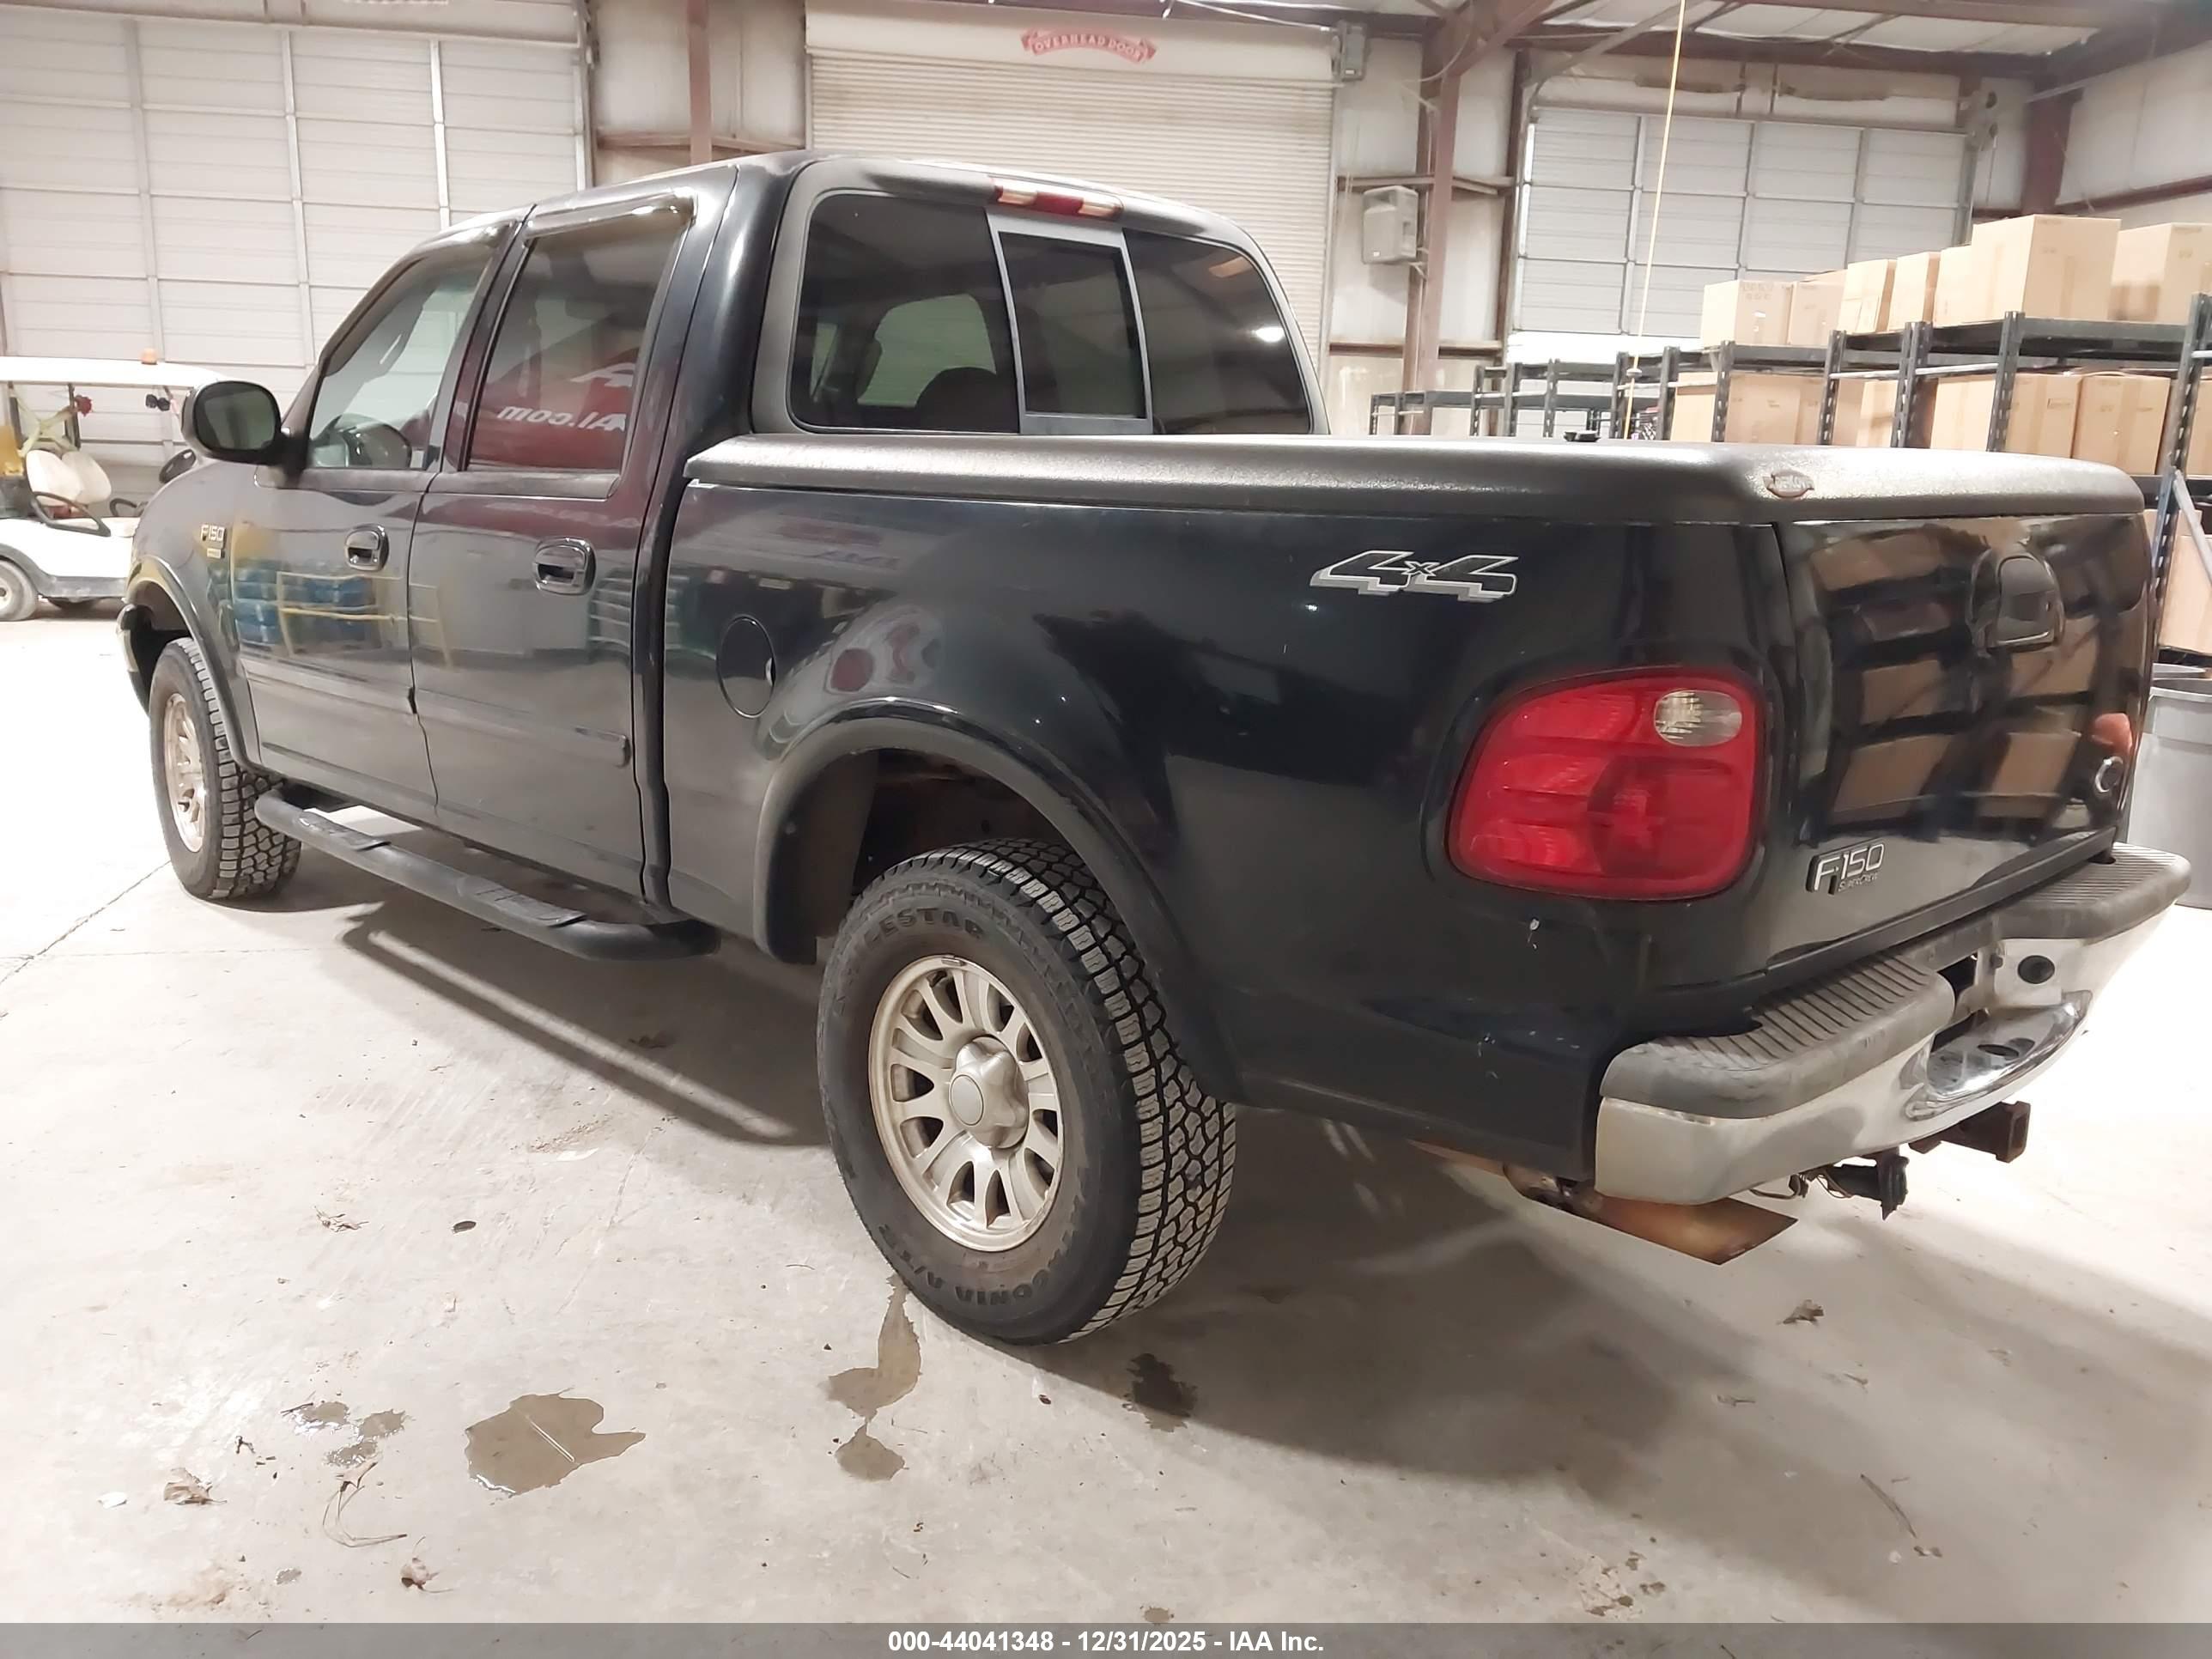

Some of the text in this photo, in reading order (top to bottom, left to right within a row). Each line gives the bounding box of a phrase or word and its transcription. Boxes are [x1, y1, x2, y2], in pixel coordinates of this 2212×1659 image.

[1035, 33, 1143, 62] OVERHEAD DOOR
[1310, 550, 1519, 603] 4x4
